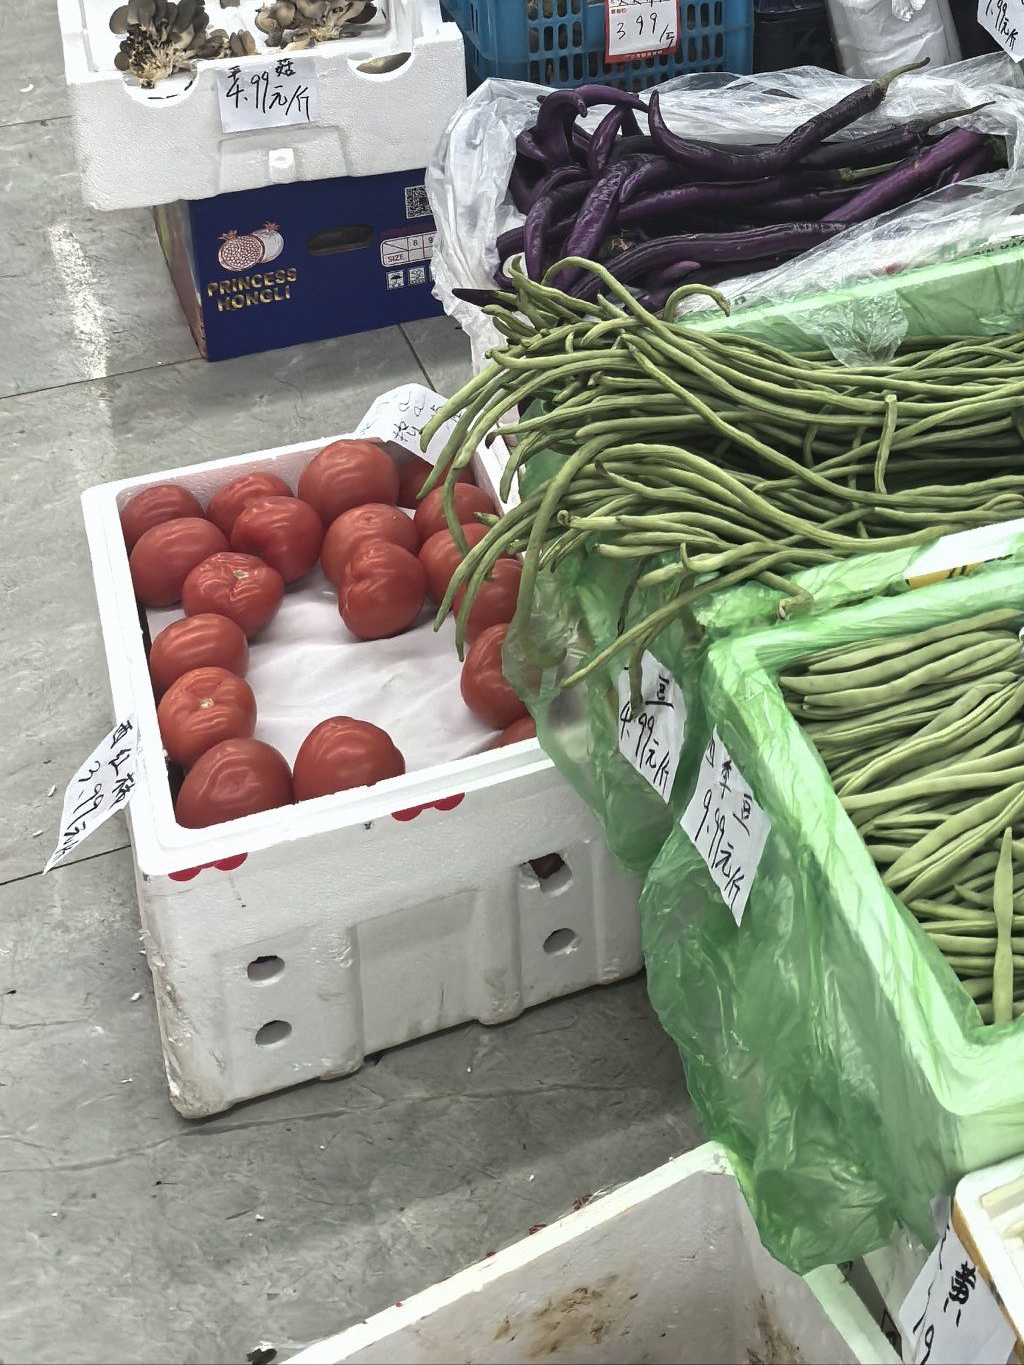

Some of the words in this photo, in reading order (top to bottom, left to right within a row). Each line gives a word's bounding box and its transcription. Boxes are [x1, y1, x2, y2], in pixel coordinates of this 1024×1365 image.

[225, 71, 311, 123] 4.99元/斤
[387, 253, 406, 264] SIZE
[207, 267, 298, 297] PRINCESS
[216, 285, 292, 312] HONGLI
[693, 788, 745, 909] 9.99元/斤
